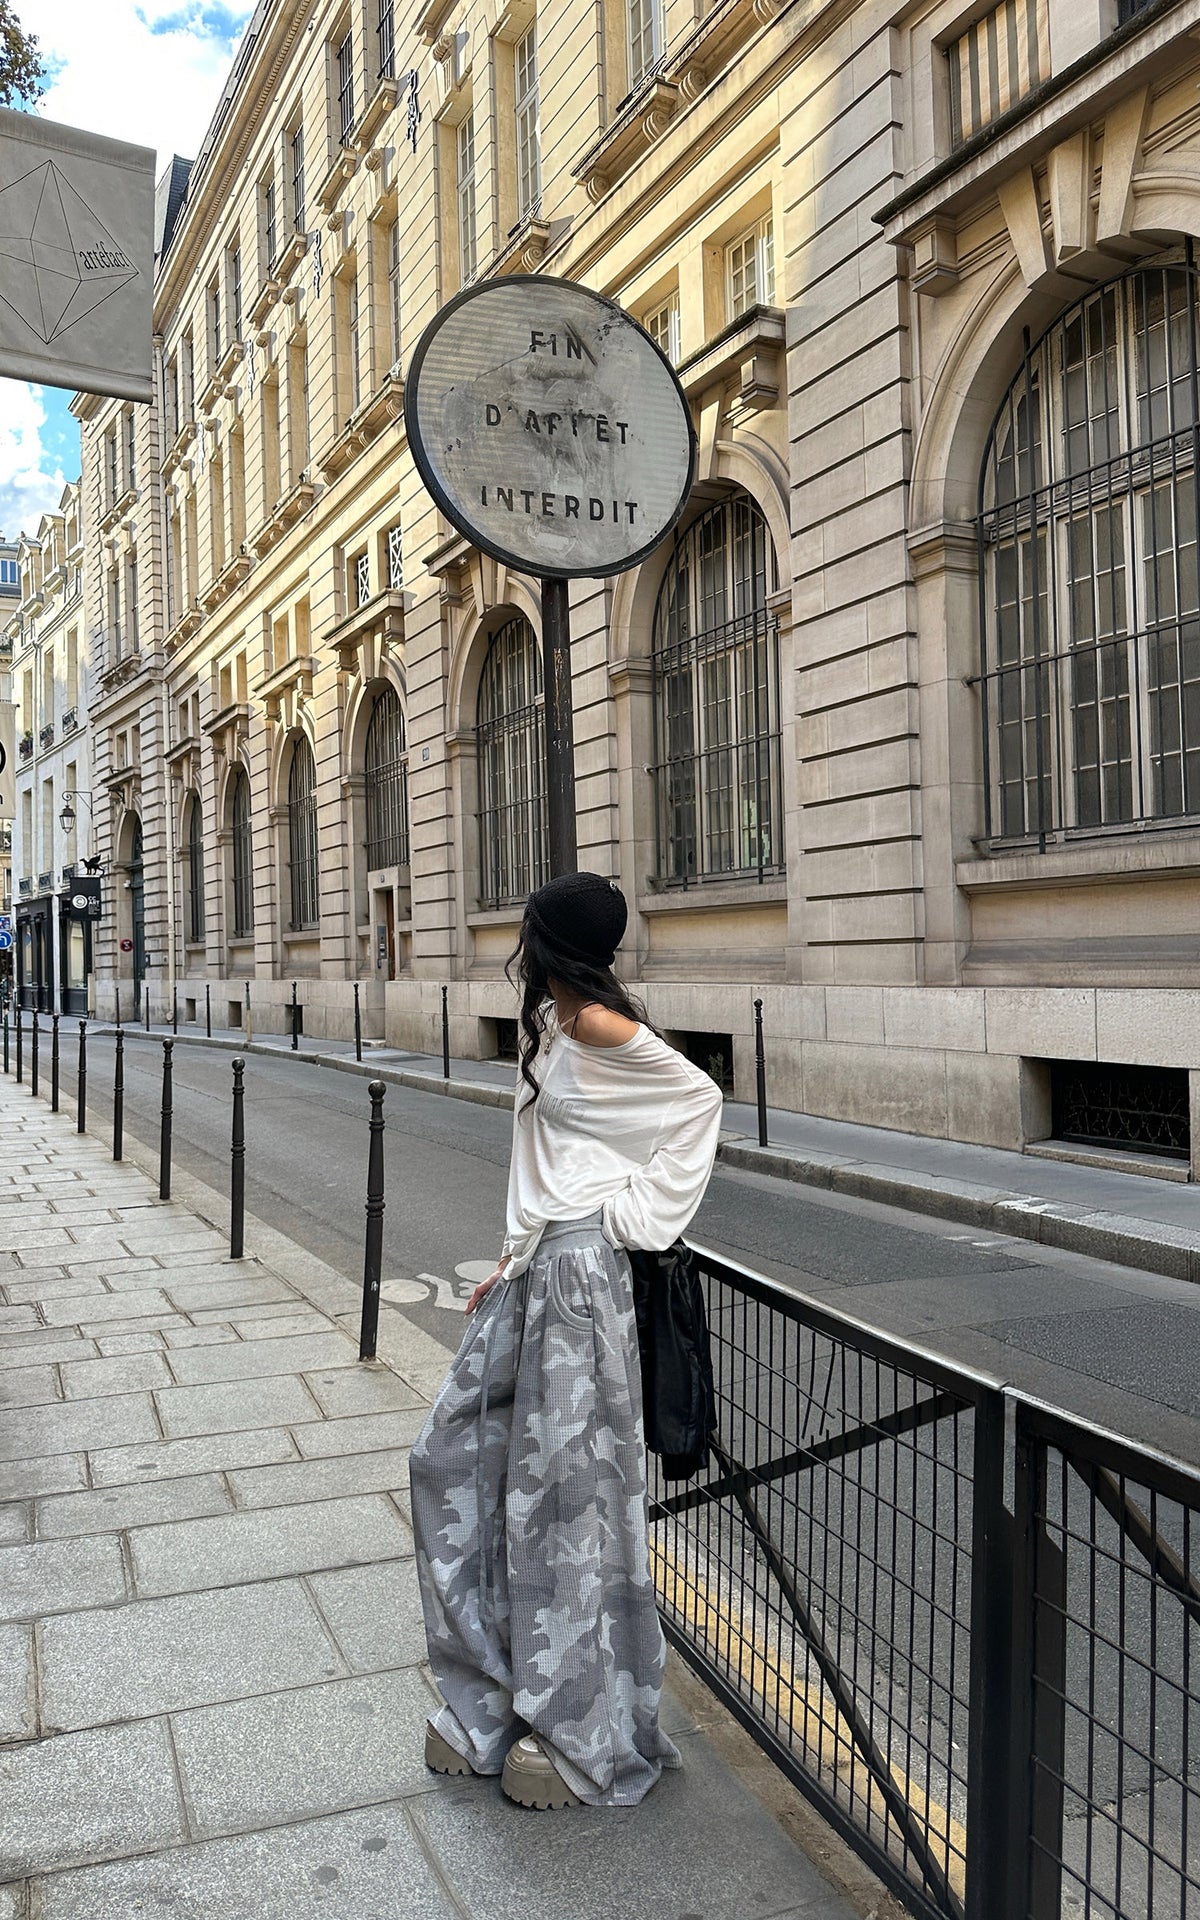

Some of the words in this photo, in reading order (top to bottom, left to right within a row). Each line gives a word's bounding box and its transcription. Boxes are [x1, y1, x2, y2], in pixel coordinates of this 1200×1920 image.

[79, 240, 130, 270] artéfact
[530, 330, 583, 360] FIN
[480, 485, 639, 525] INTERDIT
